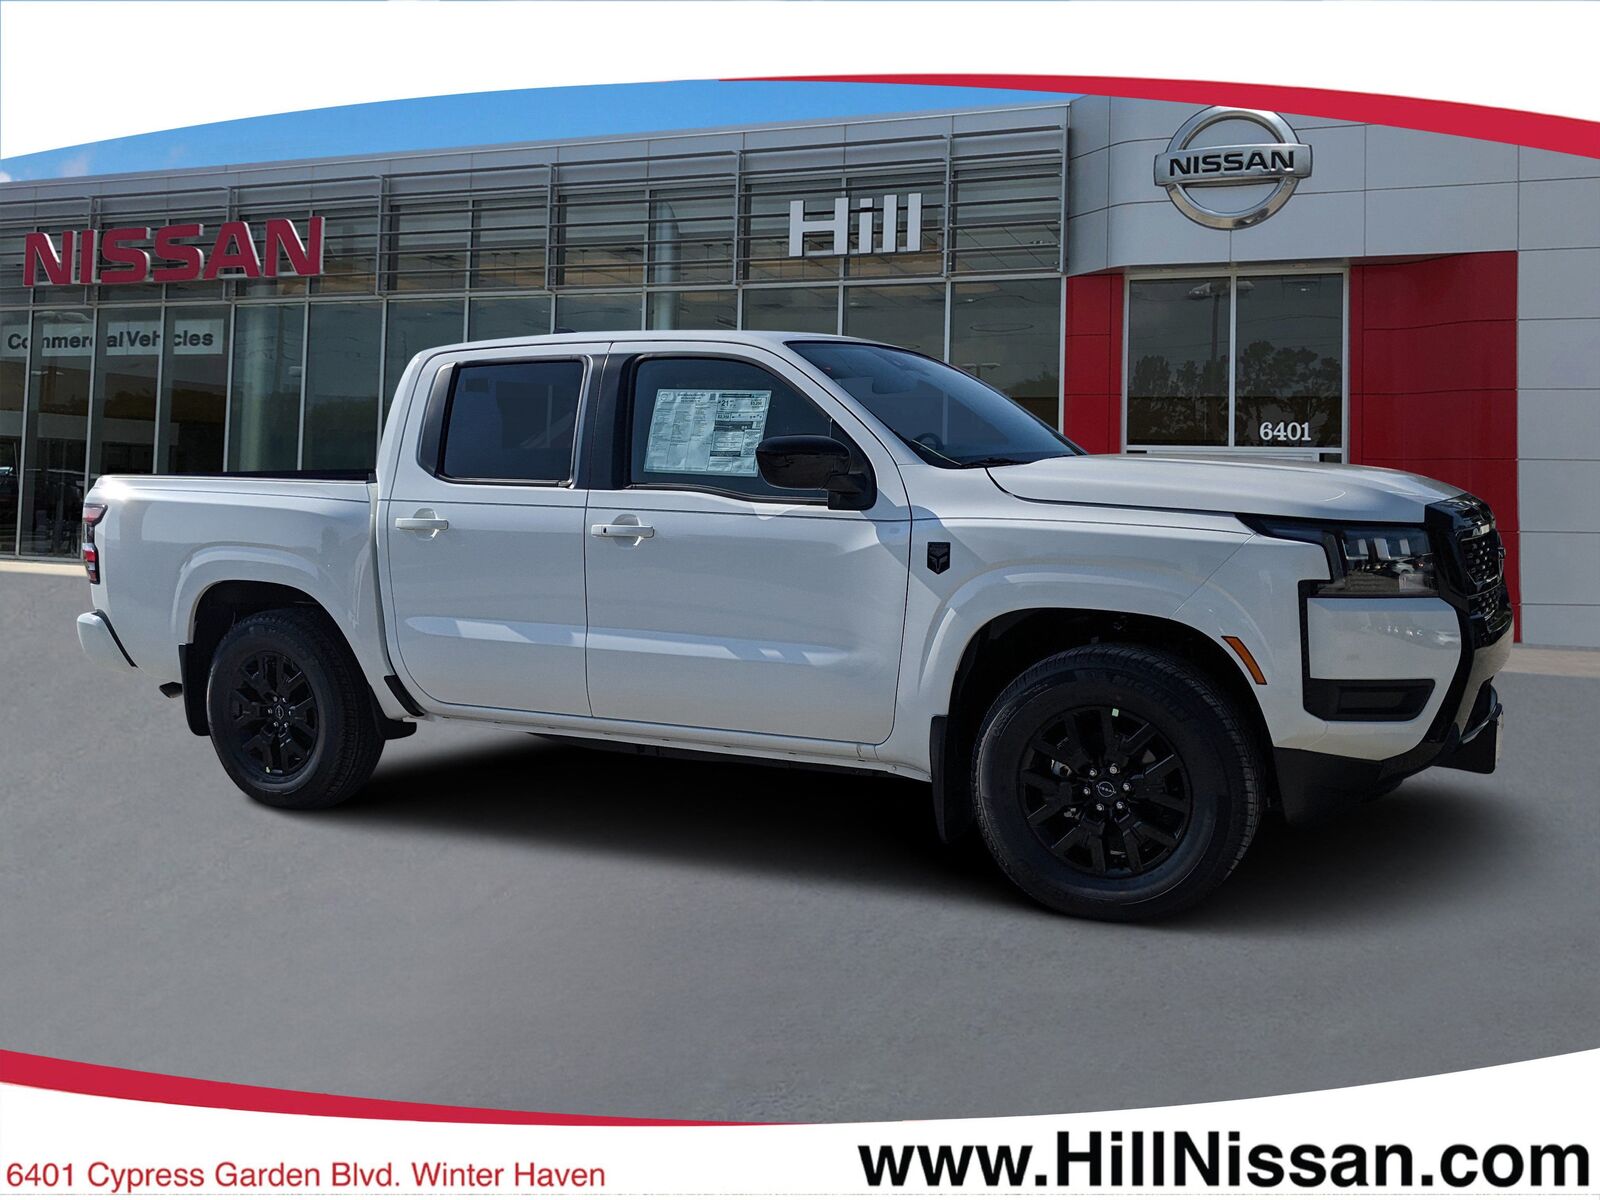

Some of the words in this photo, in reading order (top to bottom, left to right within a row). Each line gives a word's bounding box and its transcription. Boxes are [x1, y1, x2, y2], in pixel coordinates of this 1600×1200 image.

[1170, 150, 1294, 176] NISSAN
[788, 192, 922, 257] Hill
[23, 216, 324, 287] NISSAN
[8, 331, 123, 350] Commeral
[126, 330, 214, 347] Vehcles
[1259, 421, 1312, 441] 6401
